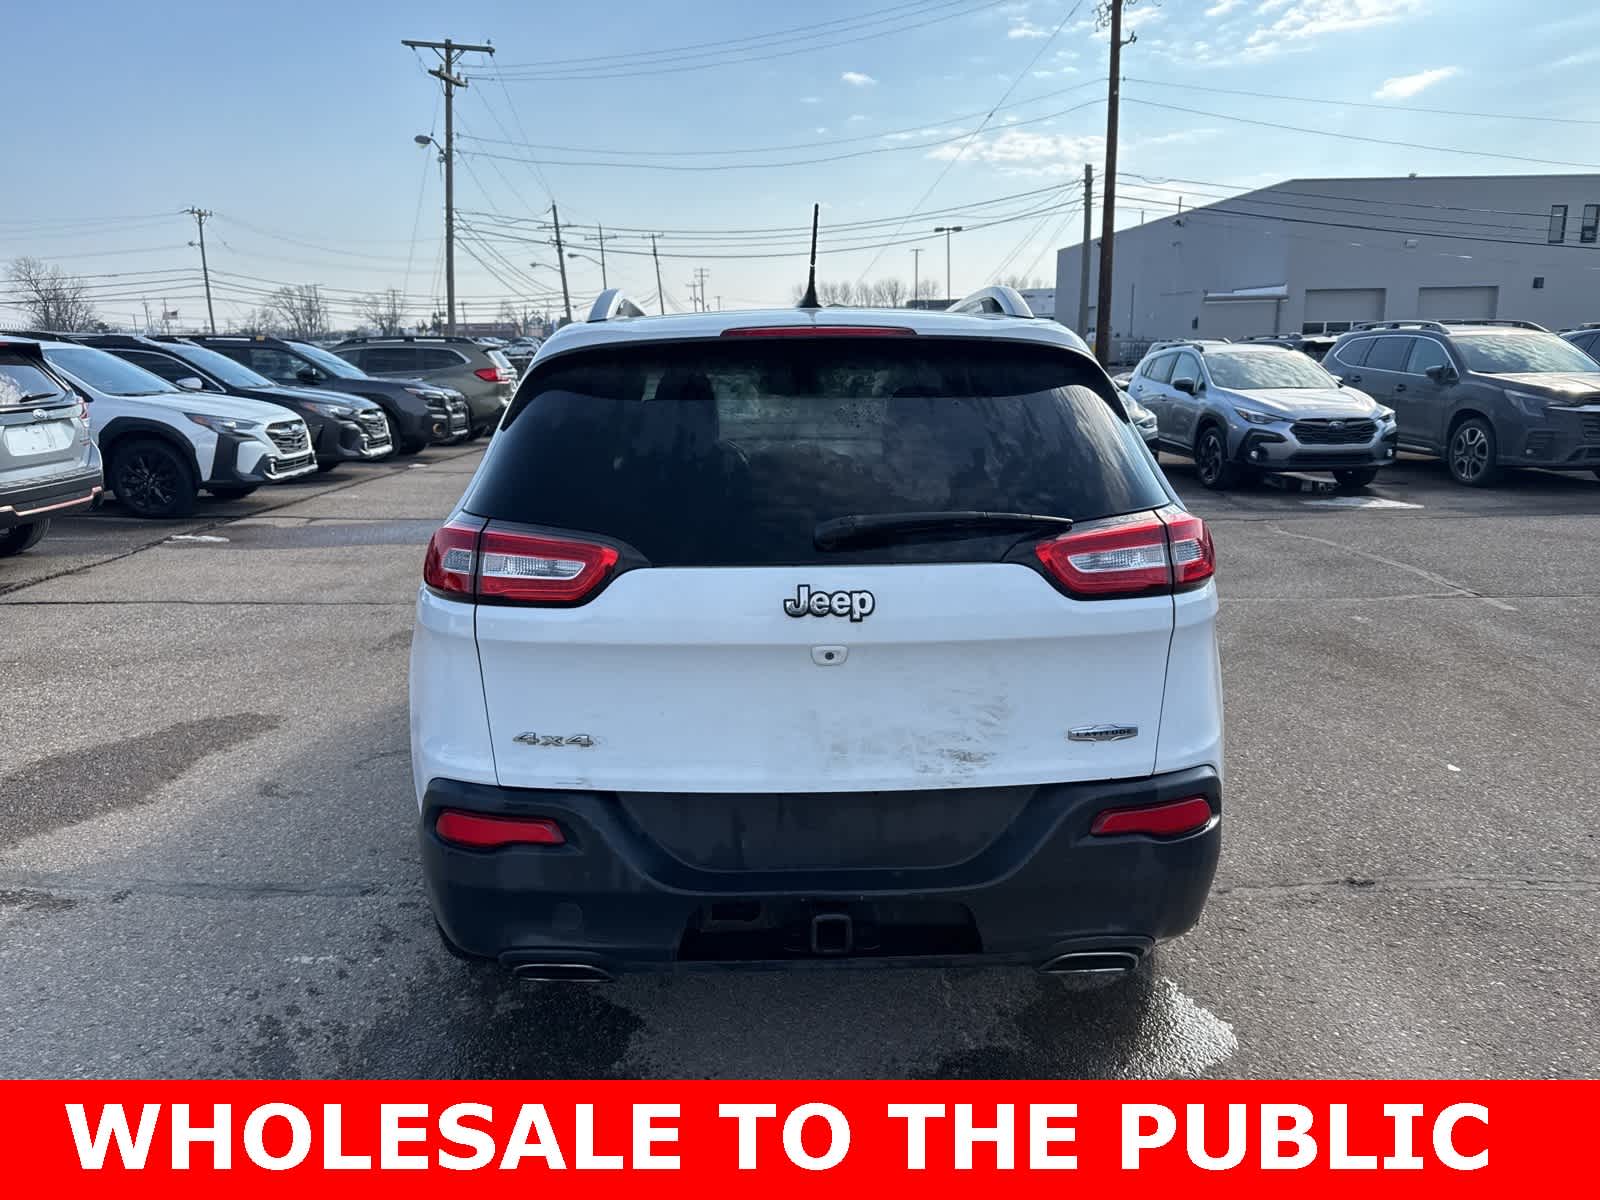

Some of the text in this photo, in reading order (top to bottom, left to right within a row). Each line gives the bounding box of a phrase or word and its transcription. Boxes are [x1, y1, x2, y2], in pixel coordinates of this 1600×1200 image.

[783, 584, 876, 622] Jeep
[513, 731, 594, 748] 4x4
[1073, 727, 1135, 738] LATITUDE
